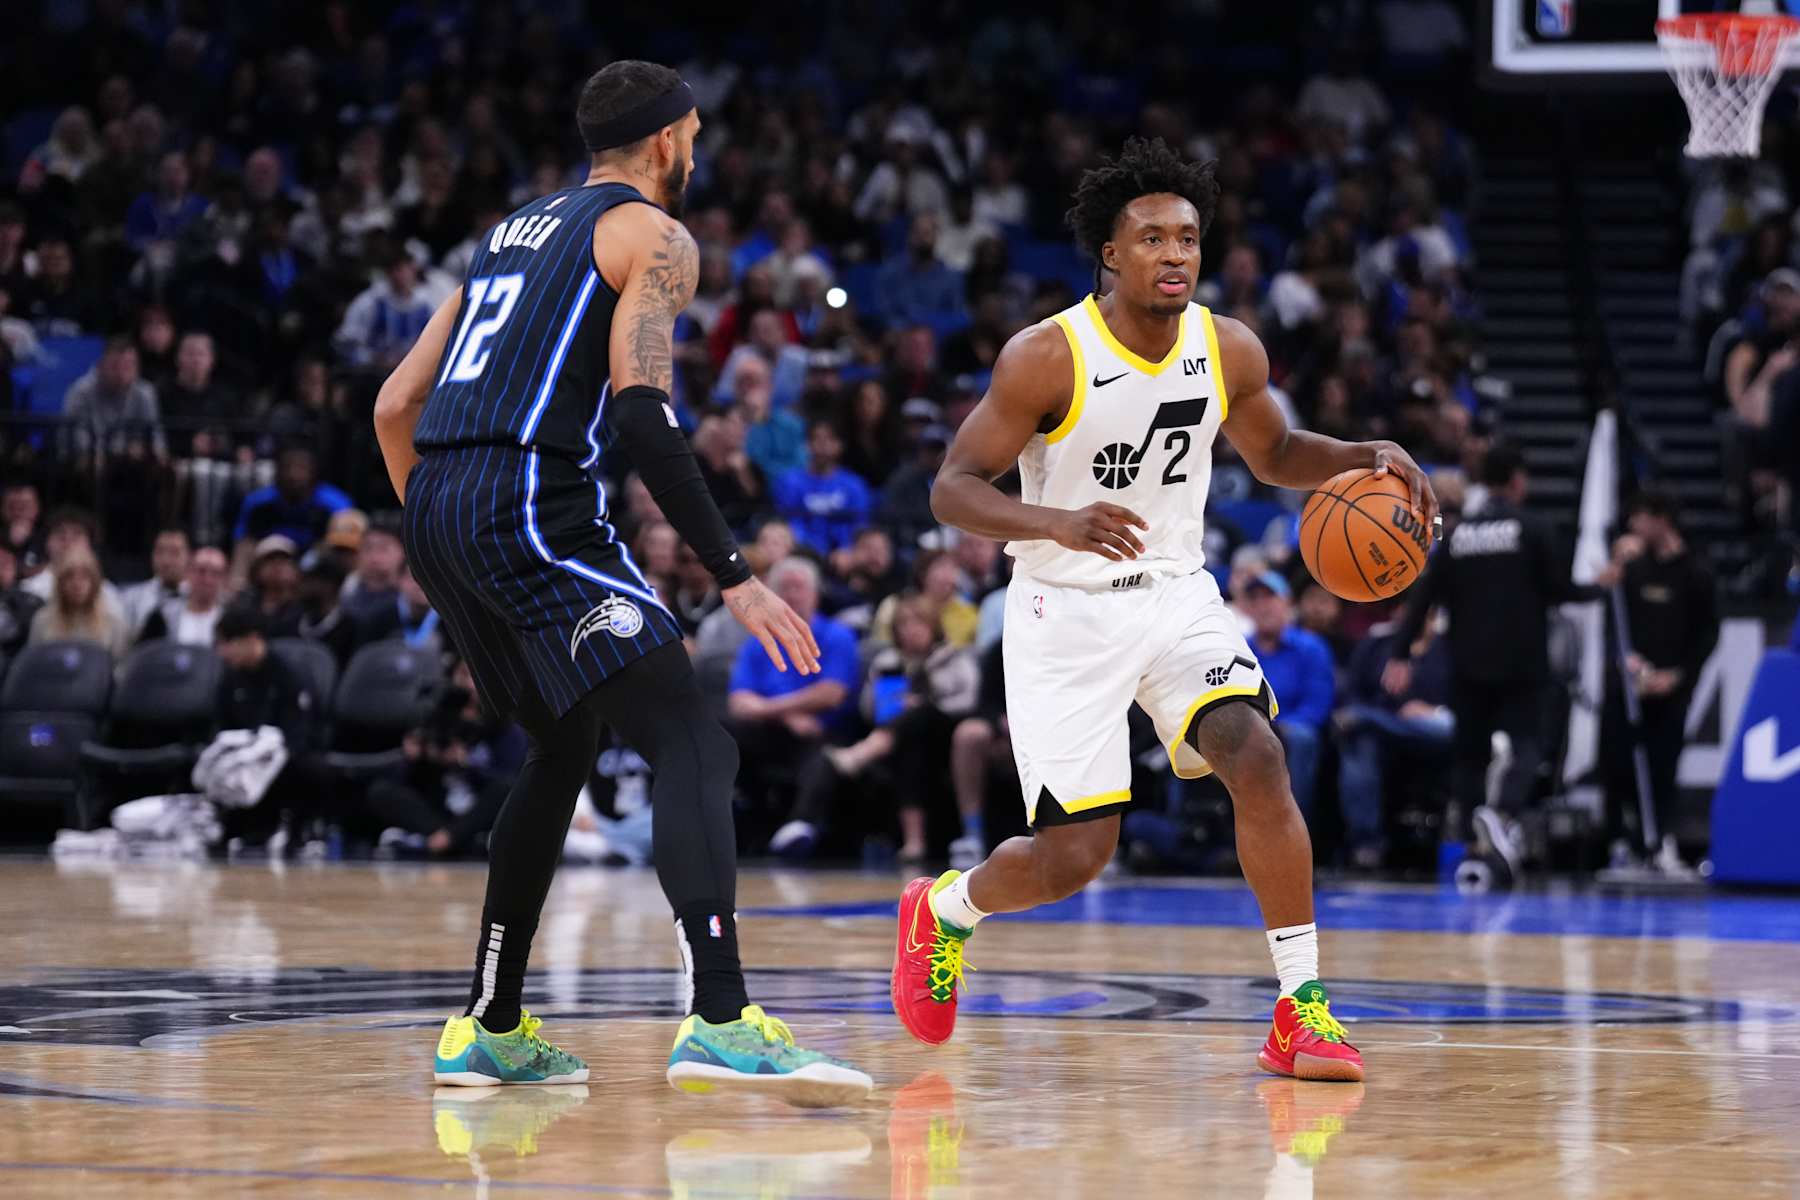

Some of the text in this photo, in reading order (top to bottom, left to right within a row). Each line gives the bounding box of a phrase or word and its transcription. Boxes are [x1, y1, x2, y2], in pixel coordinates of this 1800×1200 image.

[489, 215, 562, 254] QUEEN
[438, 272, 525, 388] 12
[1183, 357, 1207, 376] LVT
[1162, 430, 1191, 486] 2
